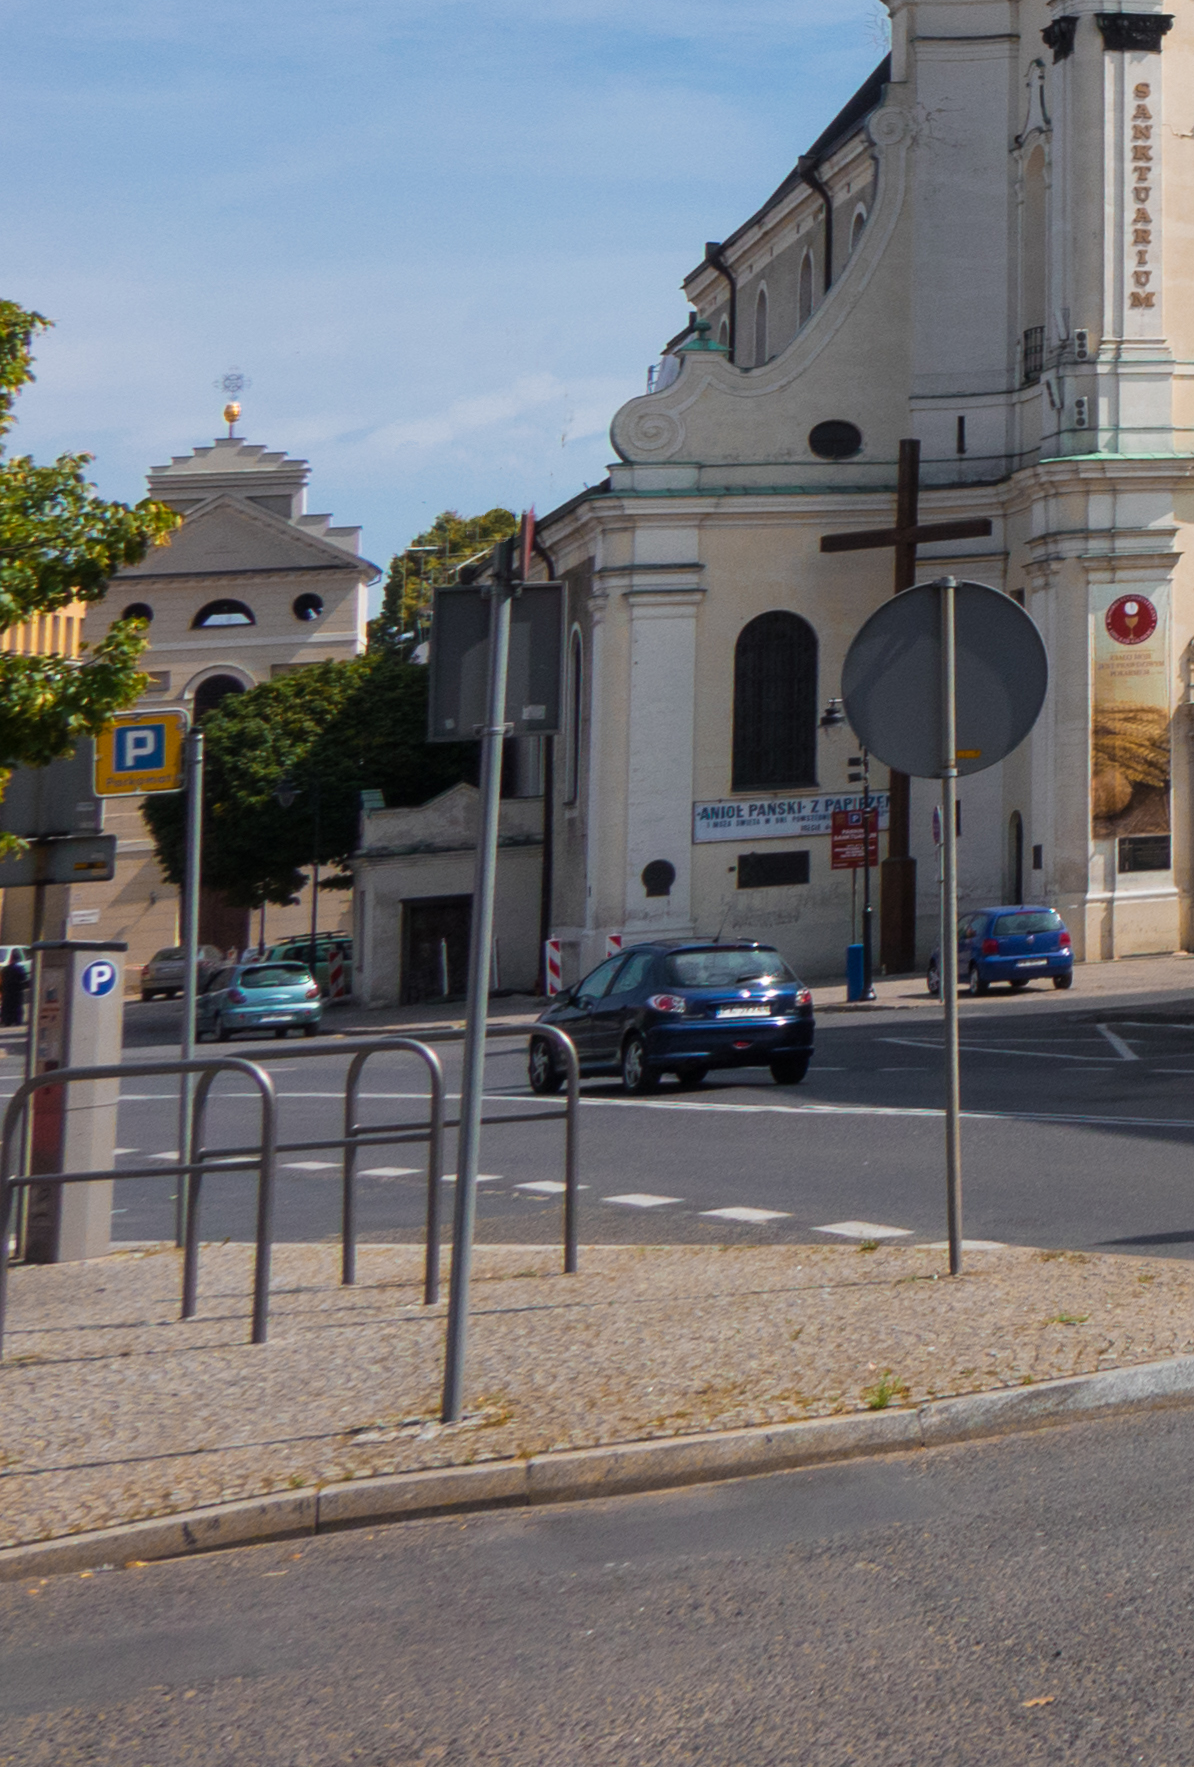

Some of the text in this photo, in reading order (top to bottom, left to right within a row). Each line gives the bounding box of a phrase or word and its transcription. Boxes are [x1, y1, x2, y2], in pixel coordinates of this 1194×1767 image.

[1129, 82, 1155, 310] SANKTUARIUM
[125, 729, 155, 767] P
[811, 799, 819, 813] Z
[89, 965, 112, 994] P
